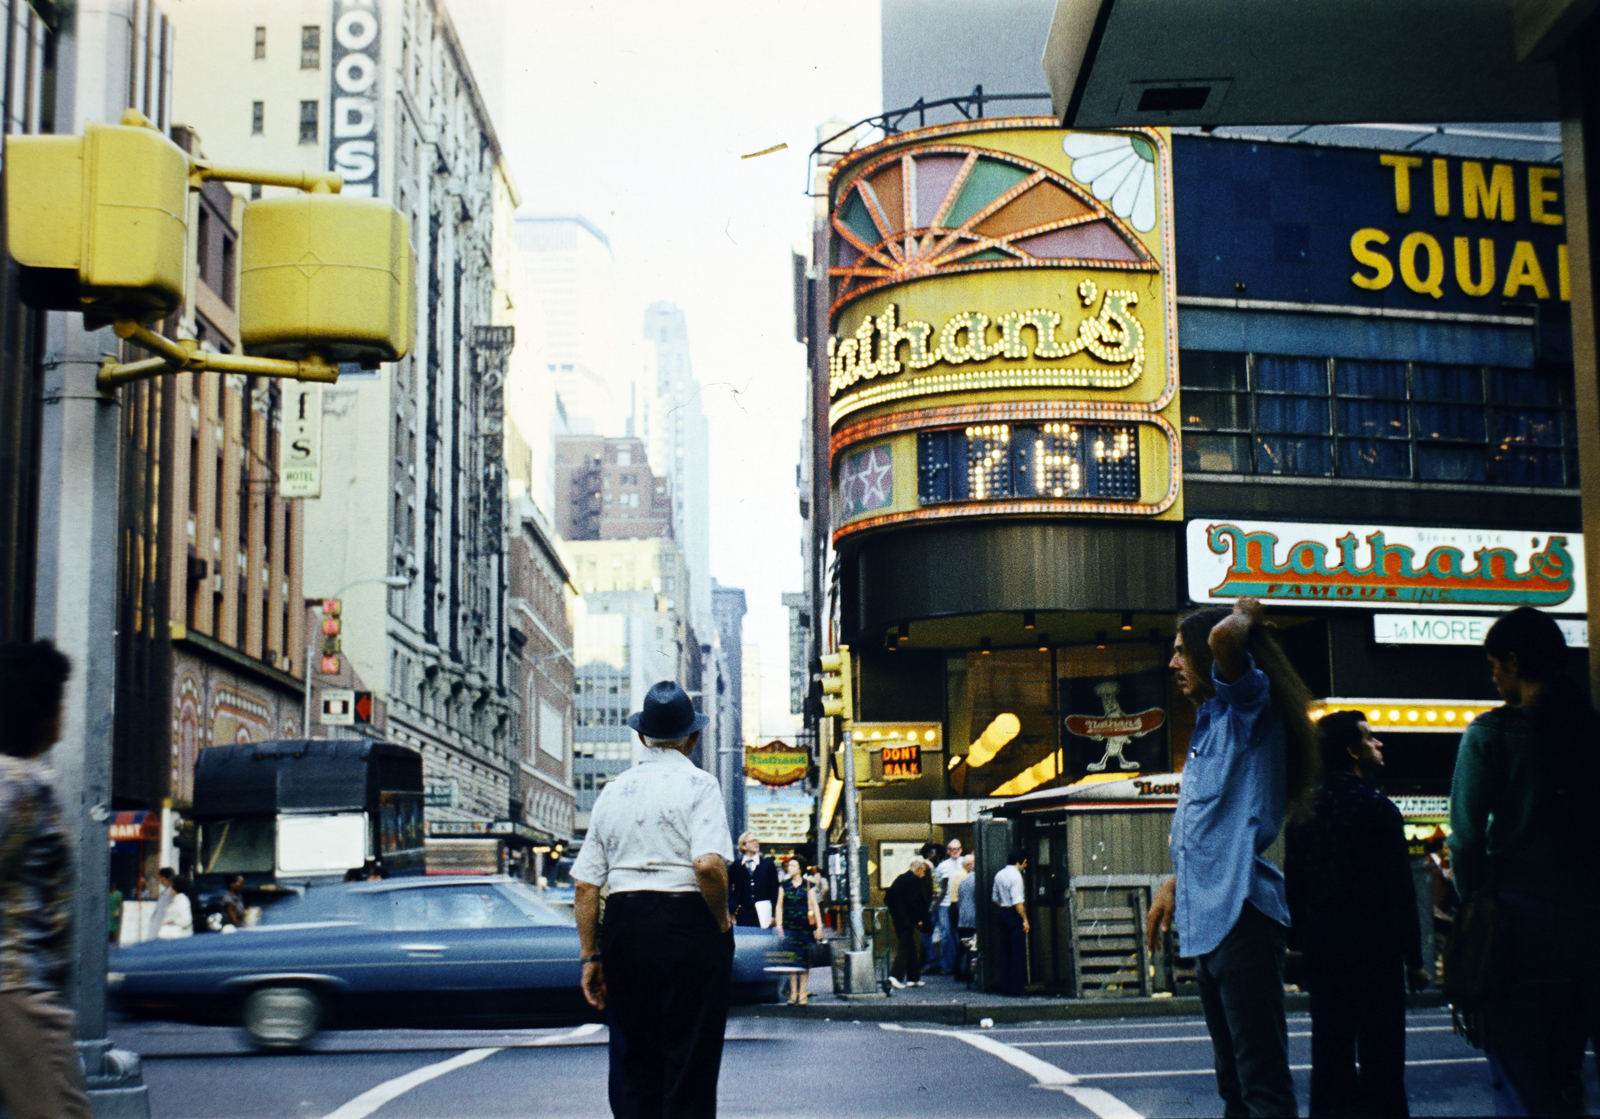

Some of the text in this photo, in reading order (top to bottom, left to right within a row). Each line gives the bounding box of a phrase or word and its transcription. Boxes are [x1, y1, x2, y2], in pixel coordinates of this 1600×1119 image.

[334, 0, 378, 196] OODS
[286, 471, 314, 481] HOTEL
[1266, 583, 1457, 601] FAMOUS INC.
[1412, 620, 1484, 642] MORE
[882, 747, 918, 761] DONT
[883, 762, 919, 776] WALK
[109, 824, 141, 837] RANT
